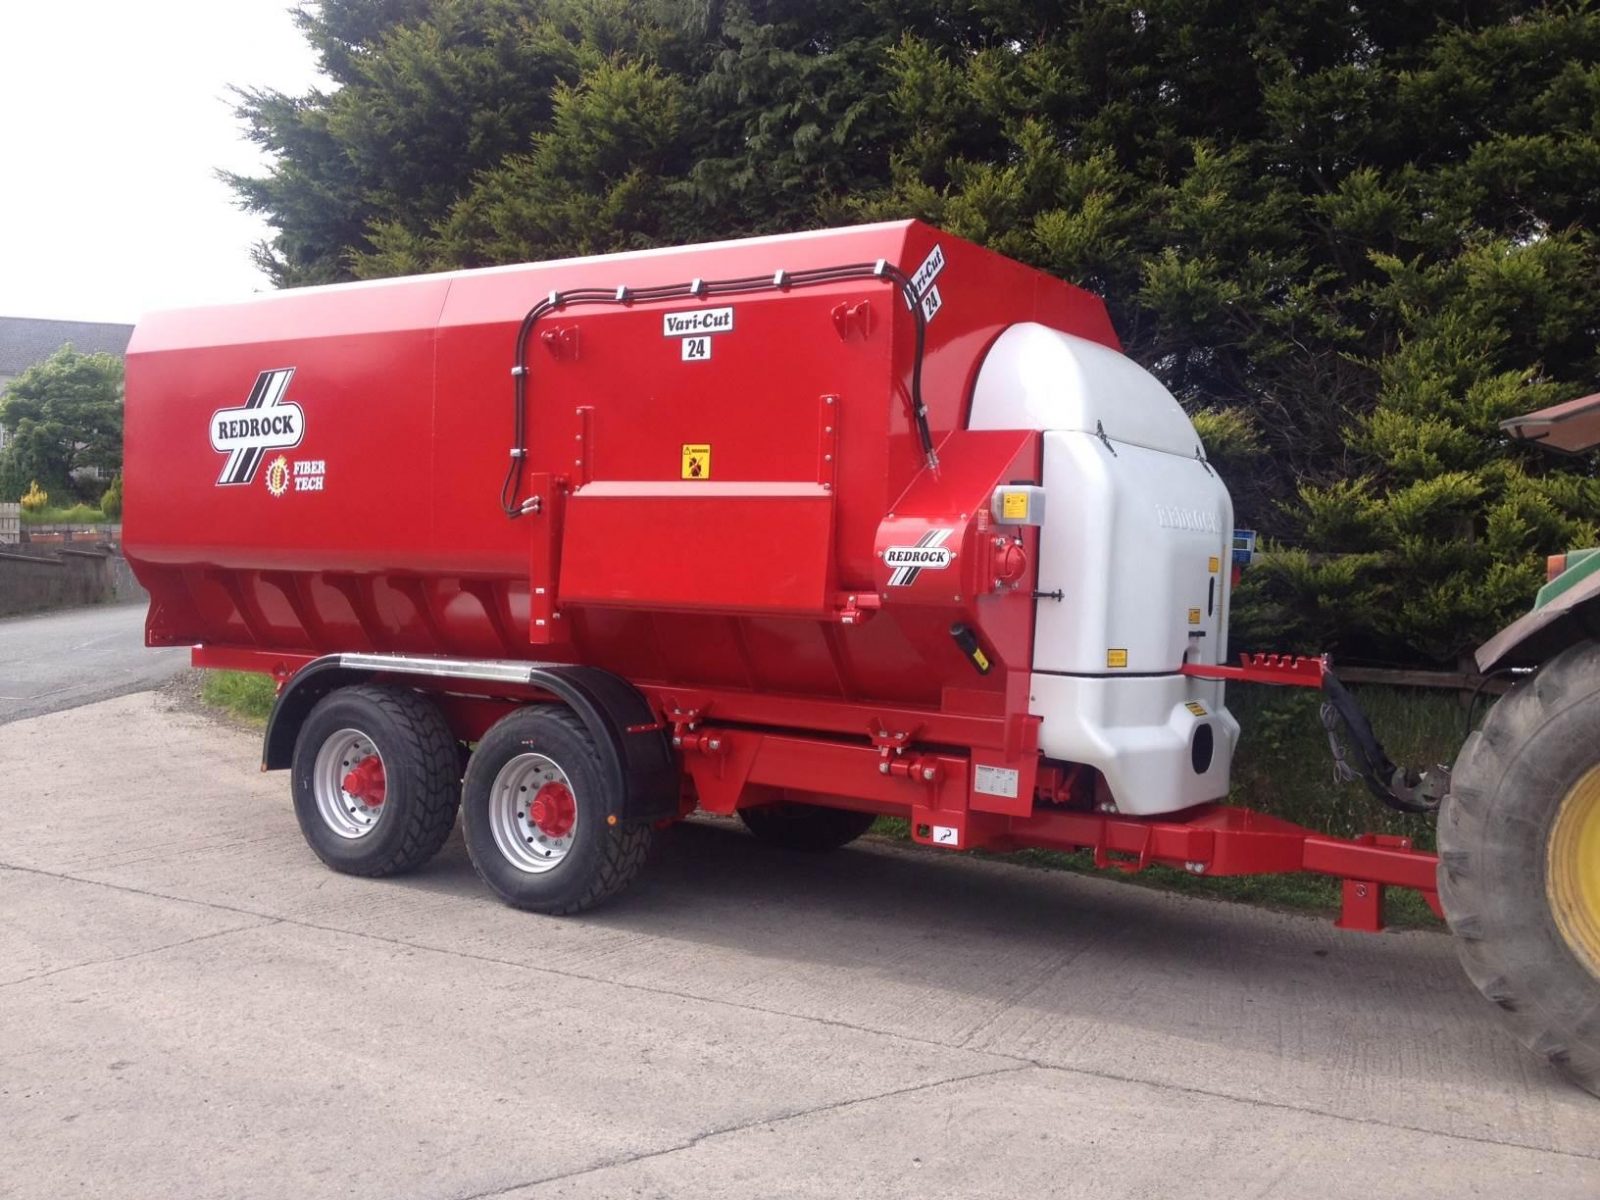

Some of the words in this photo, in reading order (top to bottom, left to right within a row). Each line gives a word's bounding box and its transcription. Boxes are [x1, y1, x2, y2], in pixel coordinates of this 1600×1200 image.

[925, 291, 938, 316] 24
[666, 312, 730, 331] Vari-Cut
[688, 339, 705, 358] 24
[218, 415, 295, 439] REDROCK
[293, 460, 326, 475] FIBER
[294, 476, 324, 490] TECH
[887, 551, 946, 562] REDROCK
